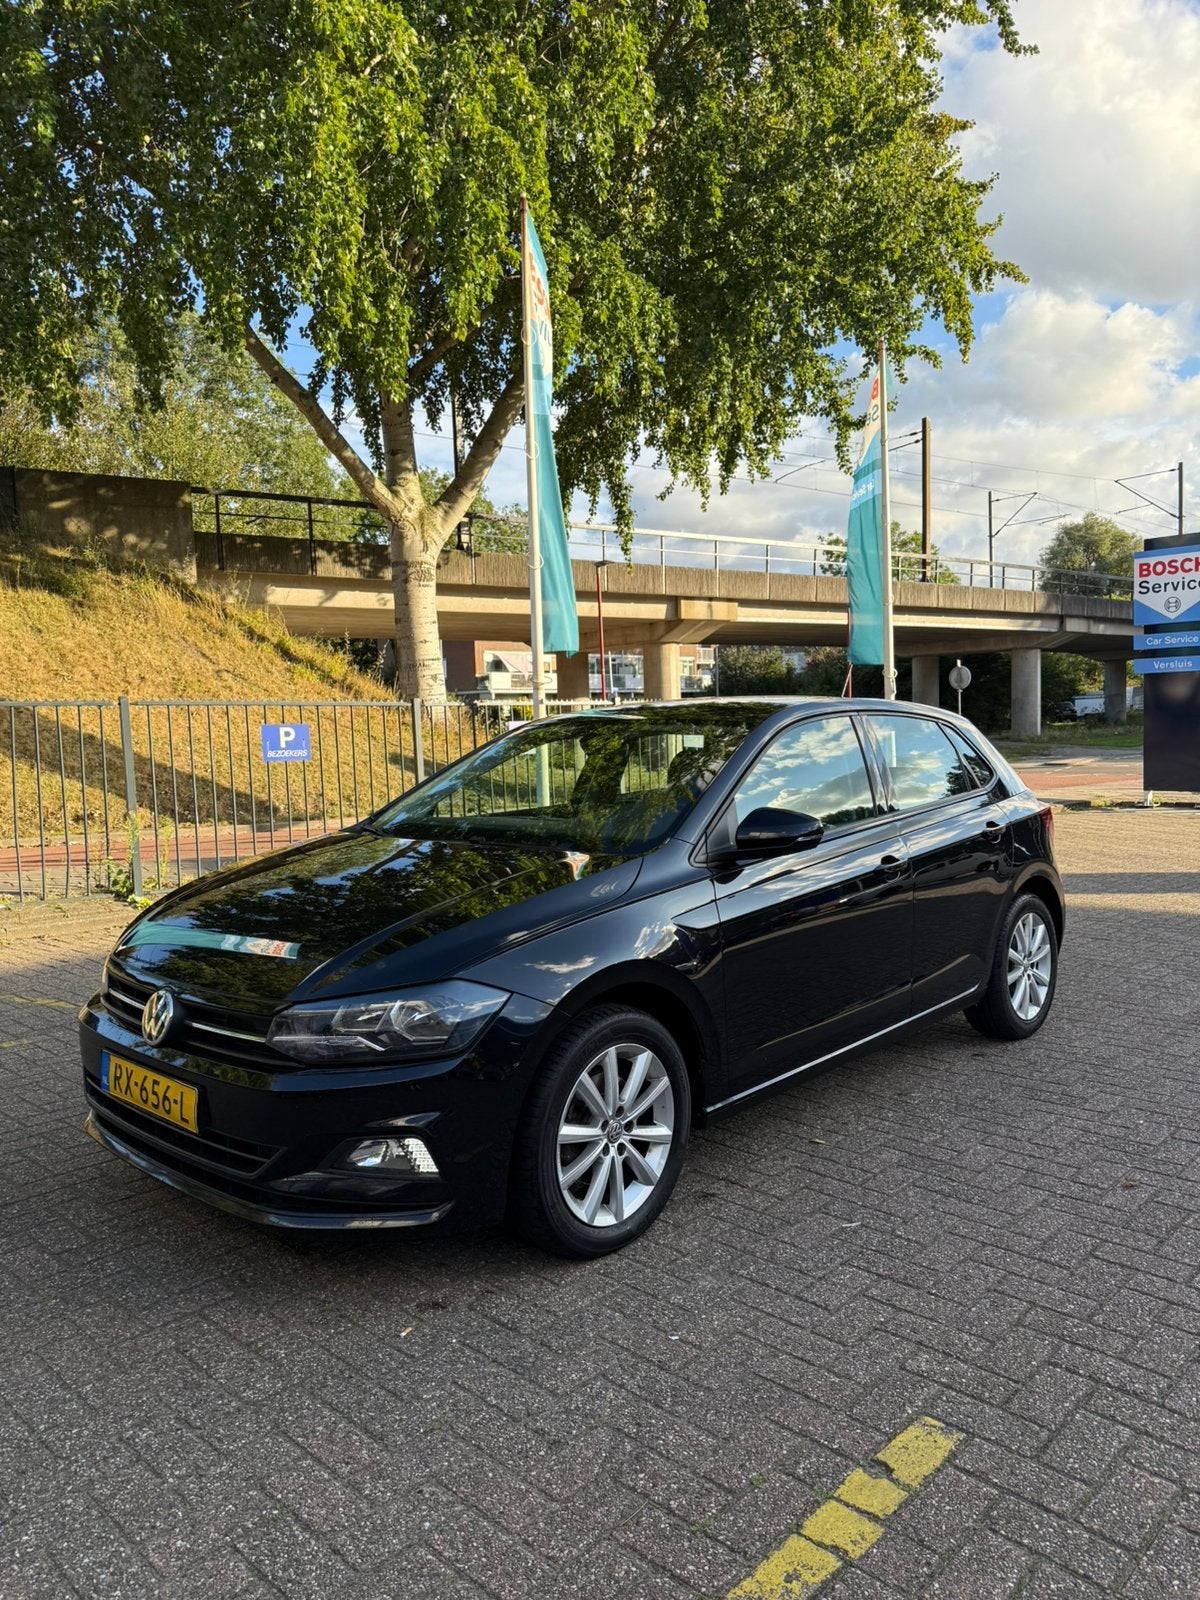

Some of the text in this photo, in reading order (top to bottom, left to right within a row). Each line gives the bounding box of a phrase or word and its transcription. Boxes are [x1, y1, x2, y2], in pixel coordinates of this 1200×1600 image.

[1138, 576, 1200, 595] Servic
[1146, 634, 1199, 646] Car Service
[1153, 660, 1193, 669] Versluis
[279, 726, 296, 748] P
[267, 749, 308, 758] BEZOEKERS
[113, 1062, 190, 1125] RX-656-L
